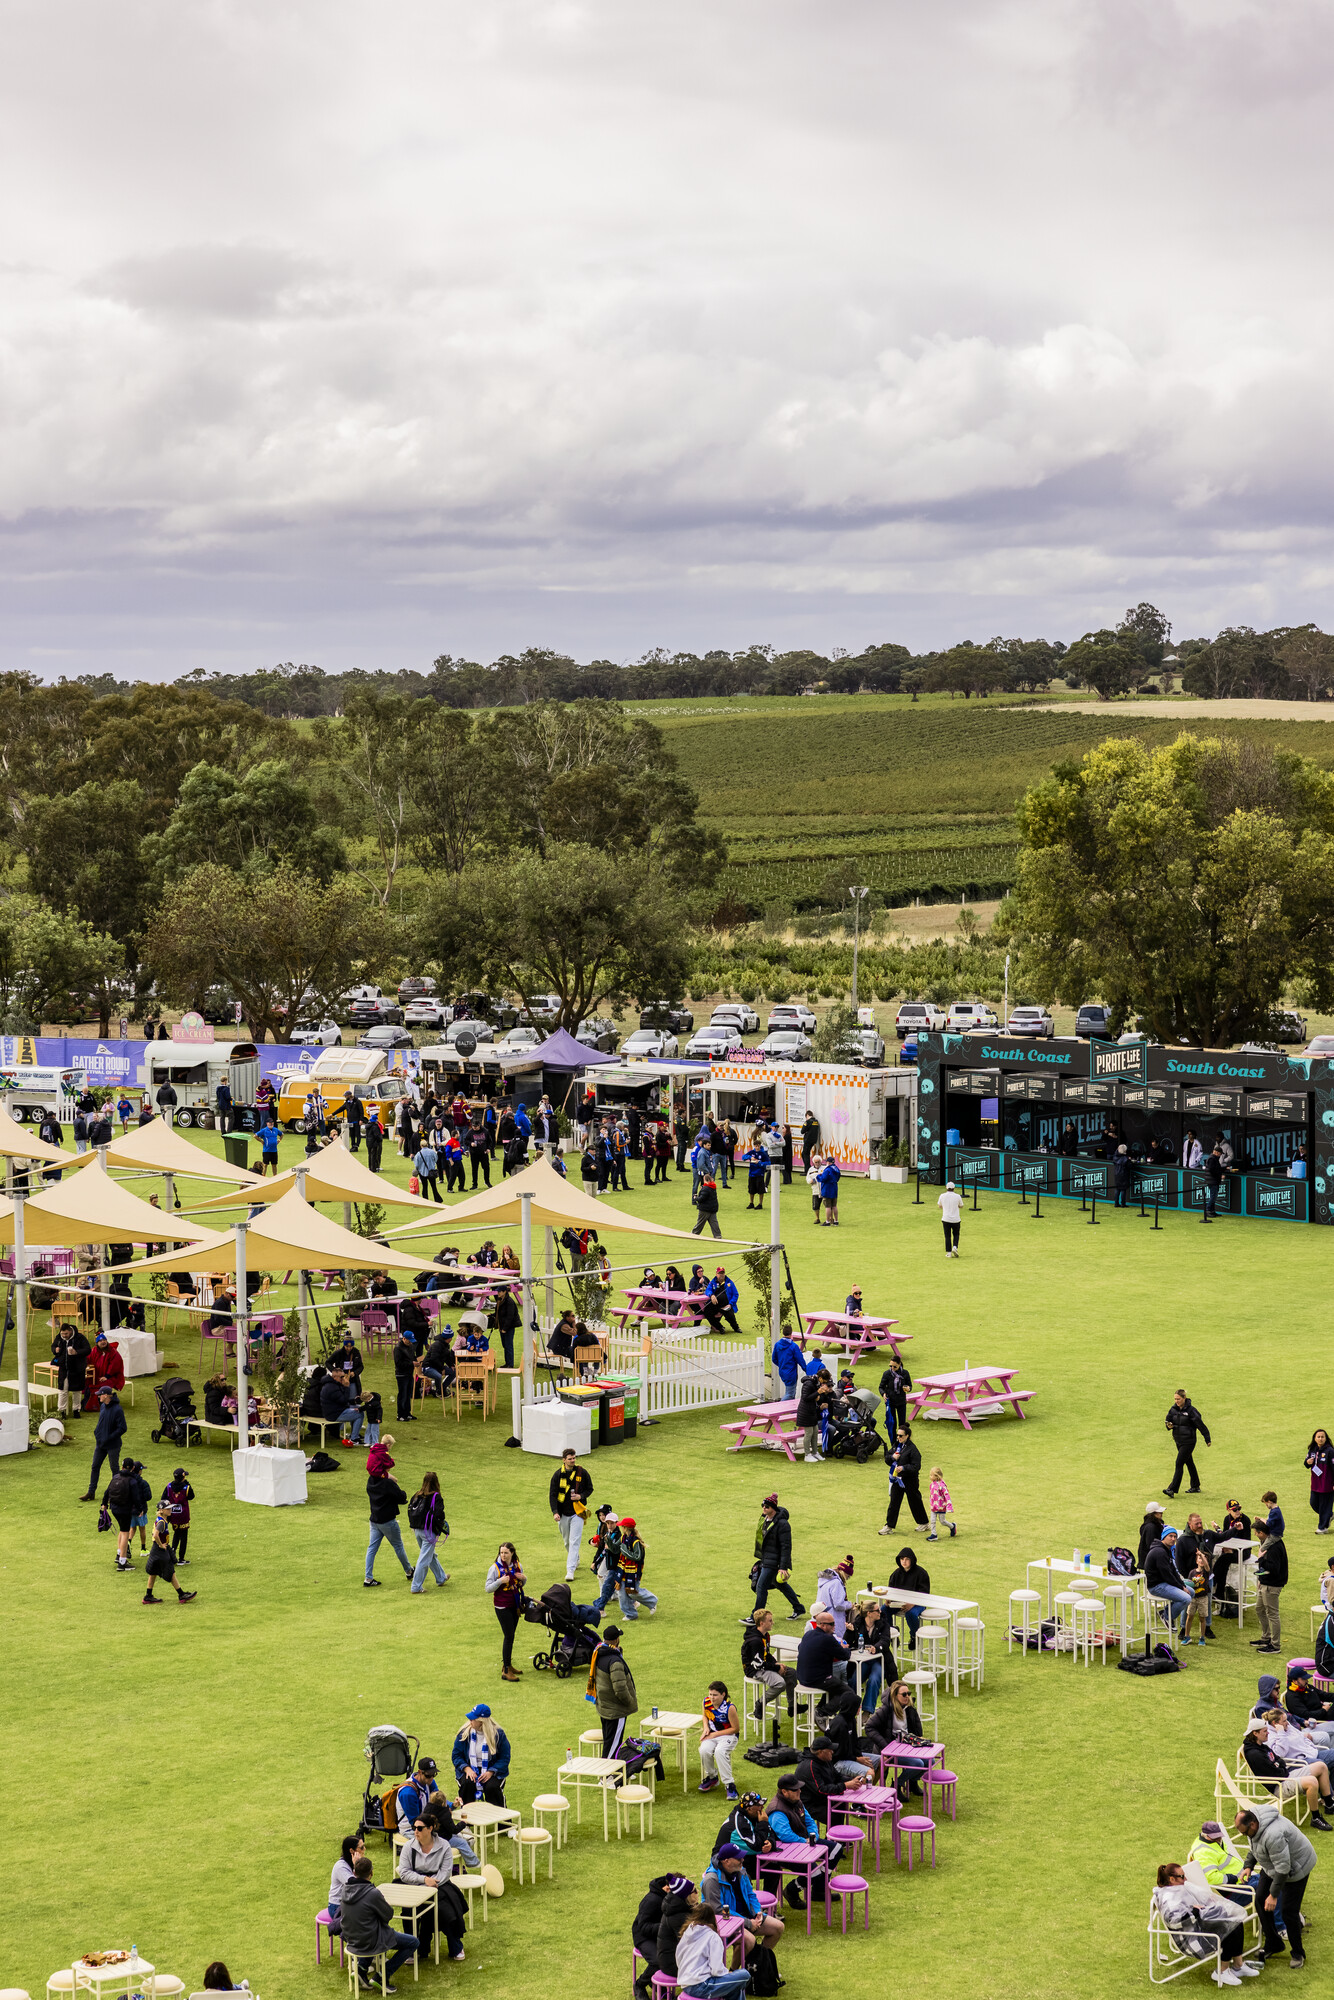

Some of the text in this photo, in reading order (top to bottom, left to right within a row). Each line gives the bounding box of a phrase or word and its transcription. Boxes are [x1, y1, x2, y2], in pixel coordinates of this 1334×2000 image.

[174, 1030, 212, 1038] ICE CREAM
[3, 1036, 14, 1065] THER
[21, 1037, 33, 1065] UND
[980, 1046, 1072, 1064] South Coast
[72, 1055, 130, 1071] GATHER ROUND
[1166, 1059, 1267, 1078] South Coast
